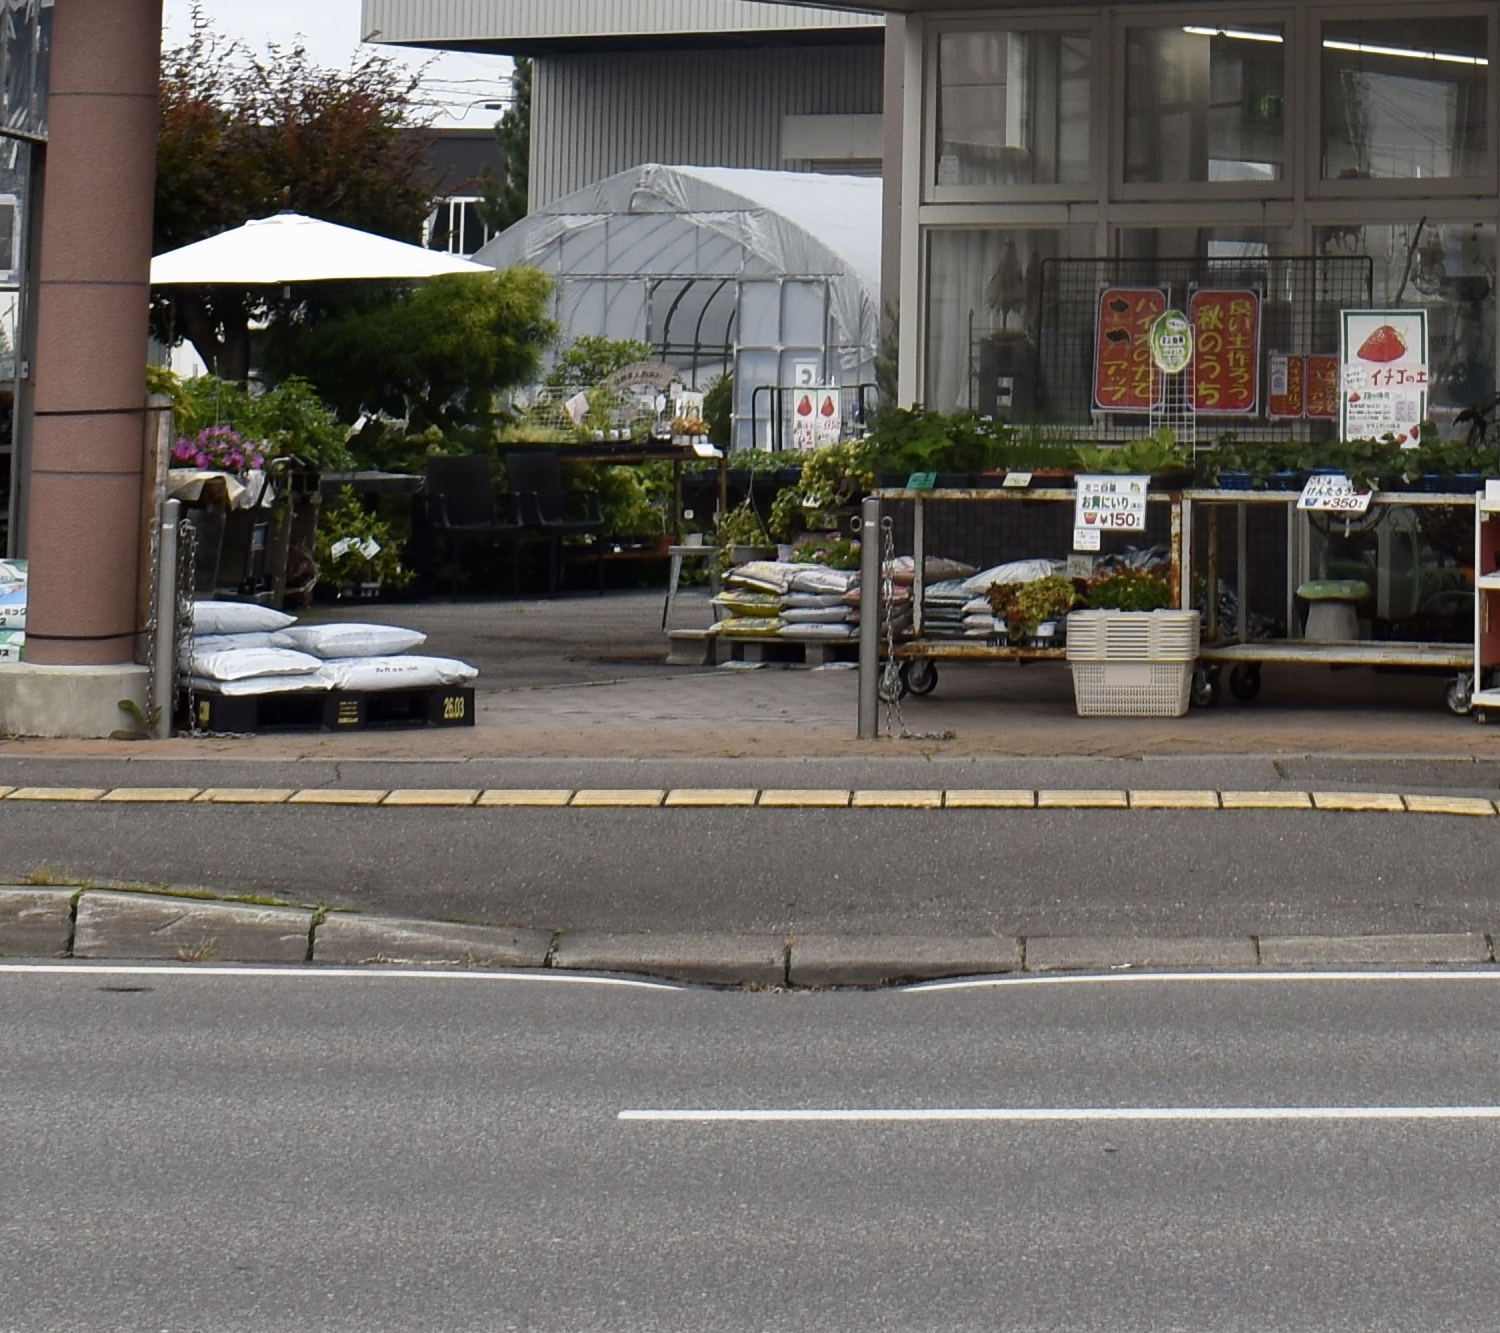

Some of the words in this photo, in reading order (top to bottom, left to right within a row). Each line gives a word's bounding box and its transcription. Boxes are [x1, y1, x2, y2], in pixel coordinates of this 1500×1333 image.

[1197, 304, 1225, 405] 秋のうち
[1226, 300, 1252, 400] 良い土作ろう
[1371, 368, 1428, 386] イチゴの土
